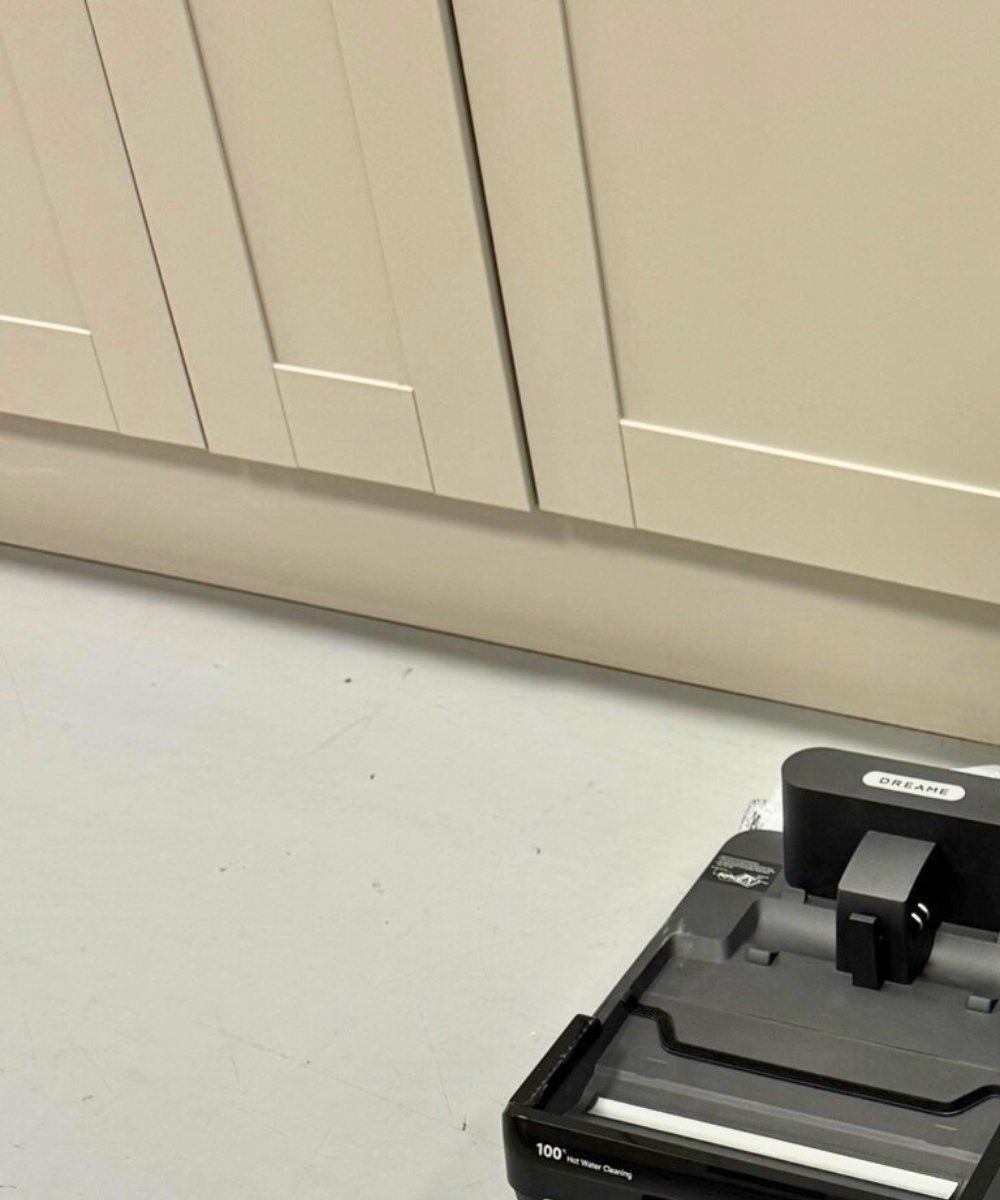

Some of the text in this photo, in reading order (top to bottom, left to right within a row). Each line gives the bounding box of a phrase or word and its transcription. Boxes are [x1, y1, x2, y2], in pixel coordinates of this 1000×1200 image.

[879, 777, 949, 796] DREAME
[566, 1155, 580, 1166] Hot
[580, 1159, 602, 1171] Water
[602, 1164, 632, 1181] Cleaning
